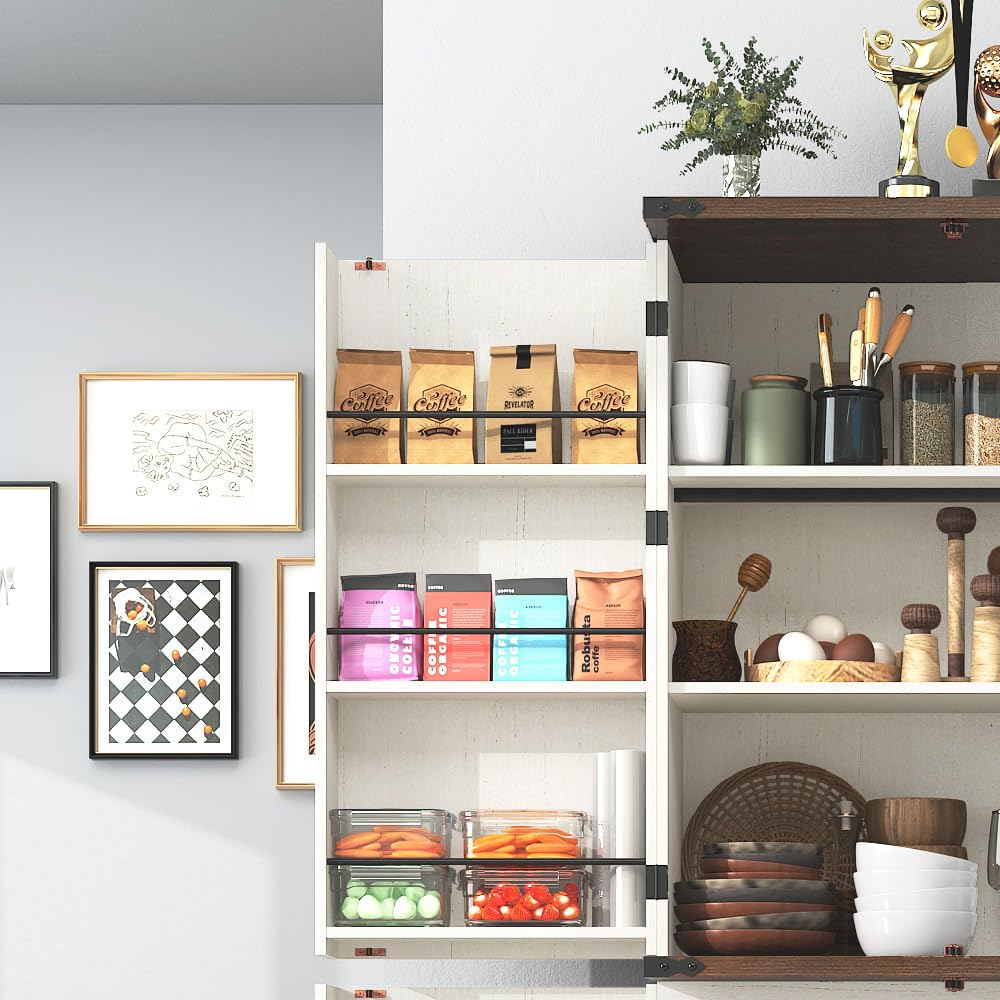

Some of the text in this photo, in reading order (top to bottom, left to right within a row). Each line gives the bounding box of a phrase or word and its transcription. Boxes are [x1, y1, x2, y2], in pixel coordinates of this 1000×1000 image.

[340, 392, 394, 411] Coffee
[413, 392, 467, 411] Coffee
[504, 400, 534, 410] REVELATOR
[577, 392, 631, 411] Coffee
[582, 615, 591, 673] Robuta
[592, 645, 600, 673] coffe
